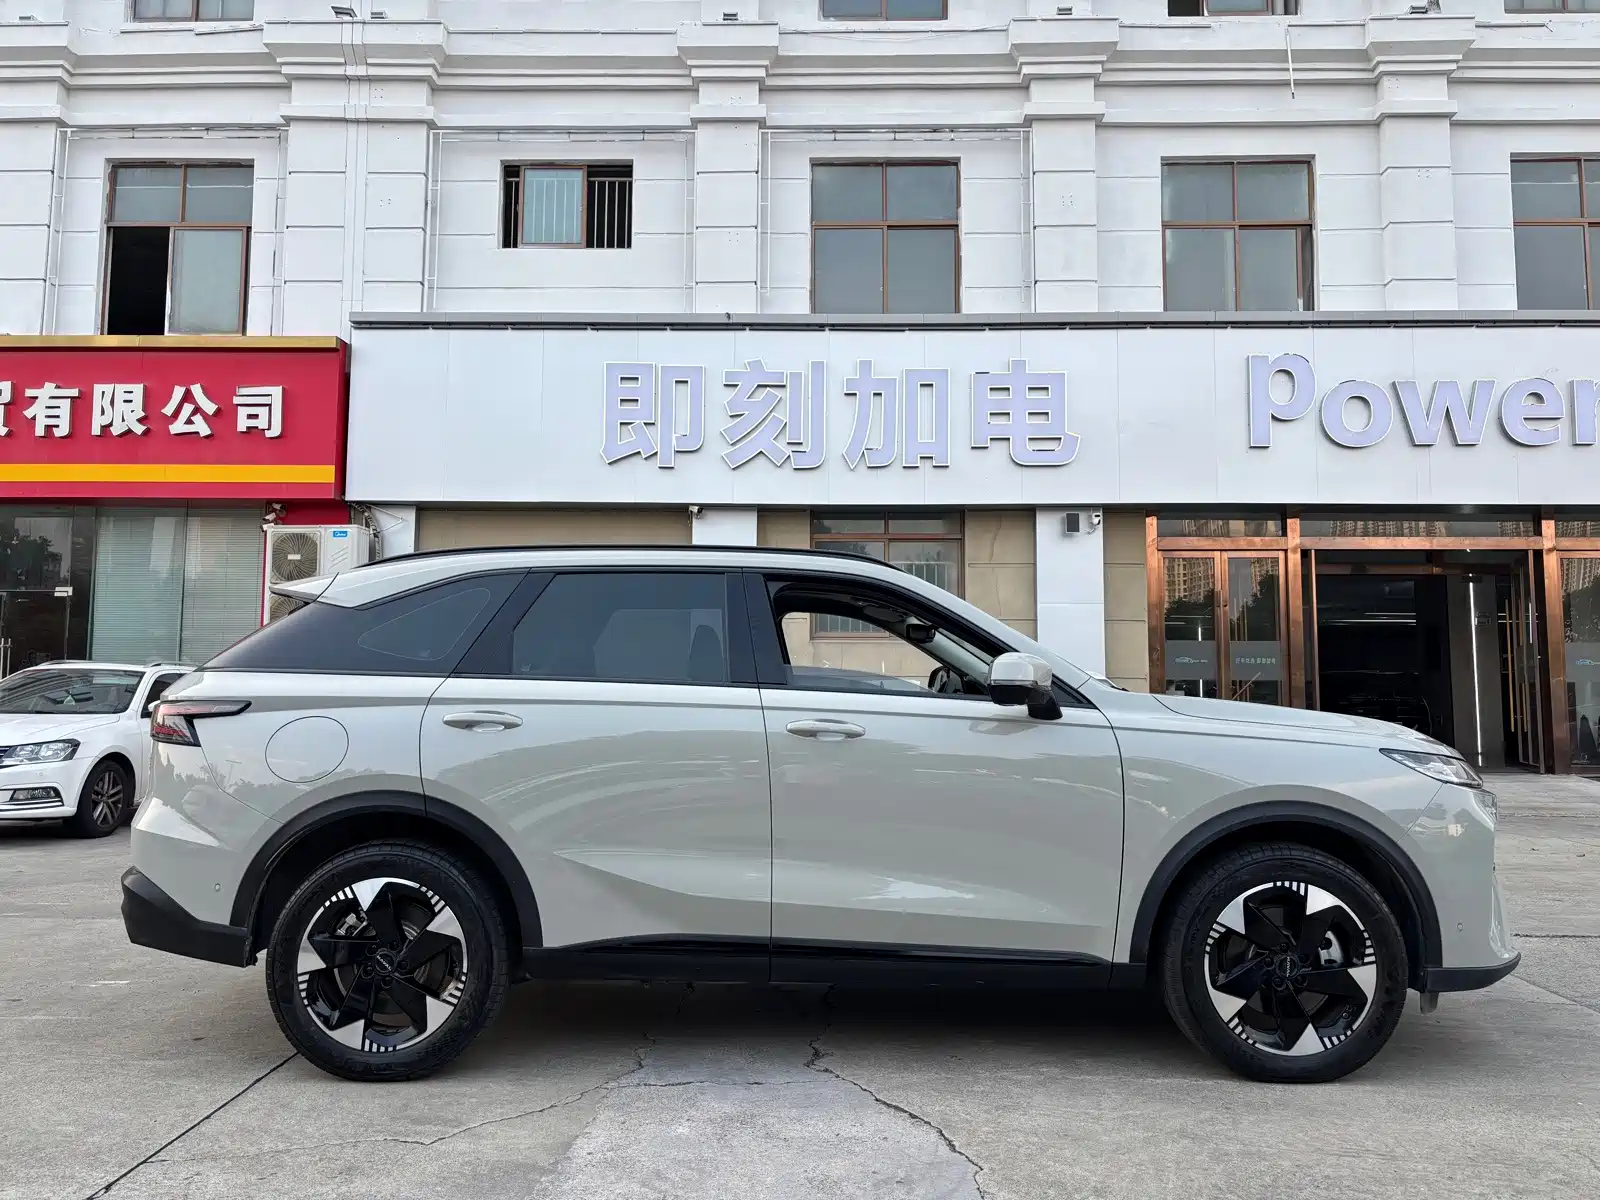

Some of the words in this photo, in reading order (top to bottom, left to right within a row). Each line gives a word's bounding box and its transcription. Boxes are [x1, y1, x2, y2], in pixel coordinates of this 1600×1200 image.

[0, 381, 284, 439] 有限公司
[601, 358, 1080, 470] 即刻加电
